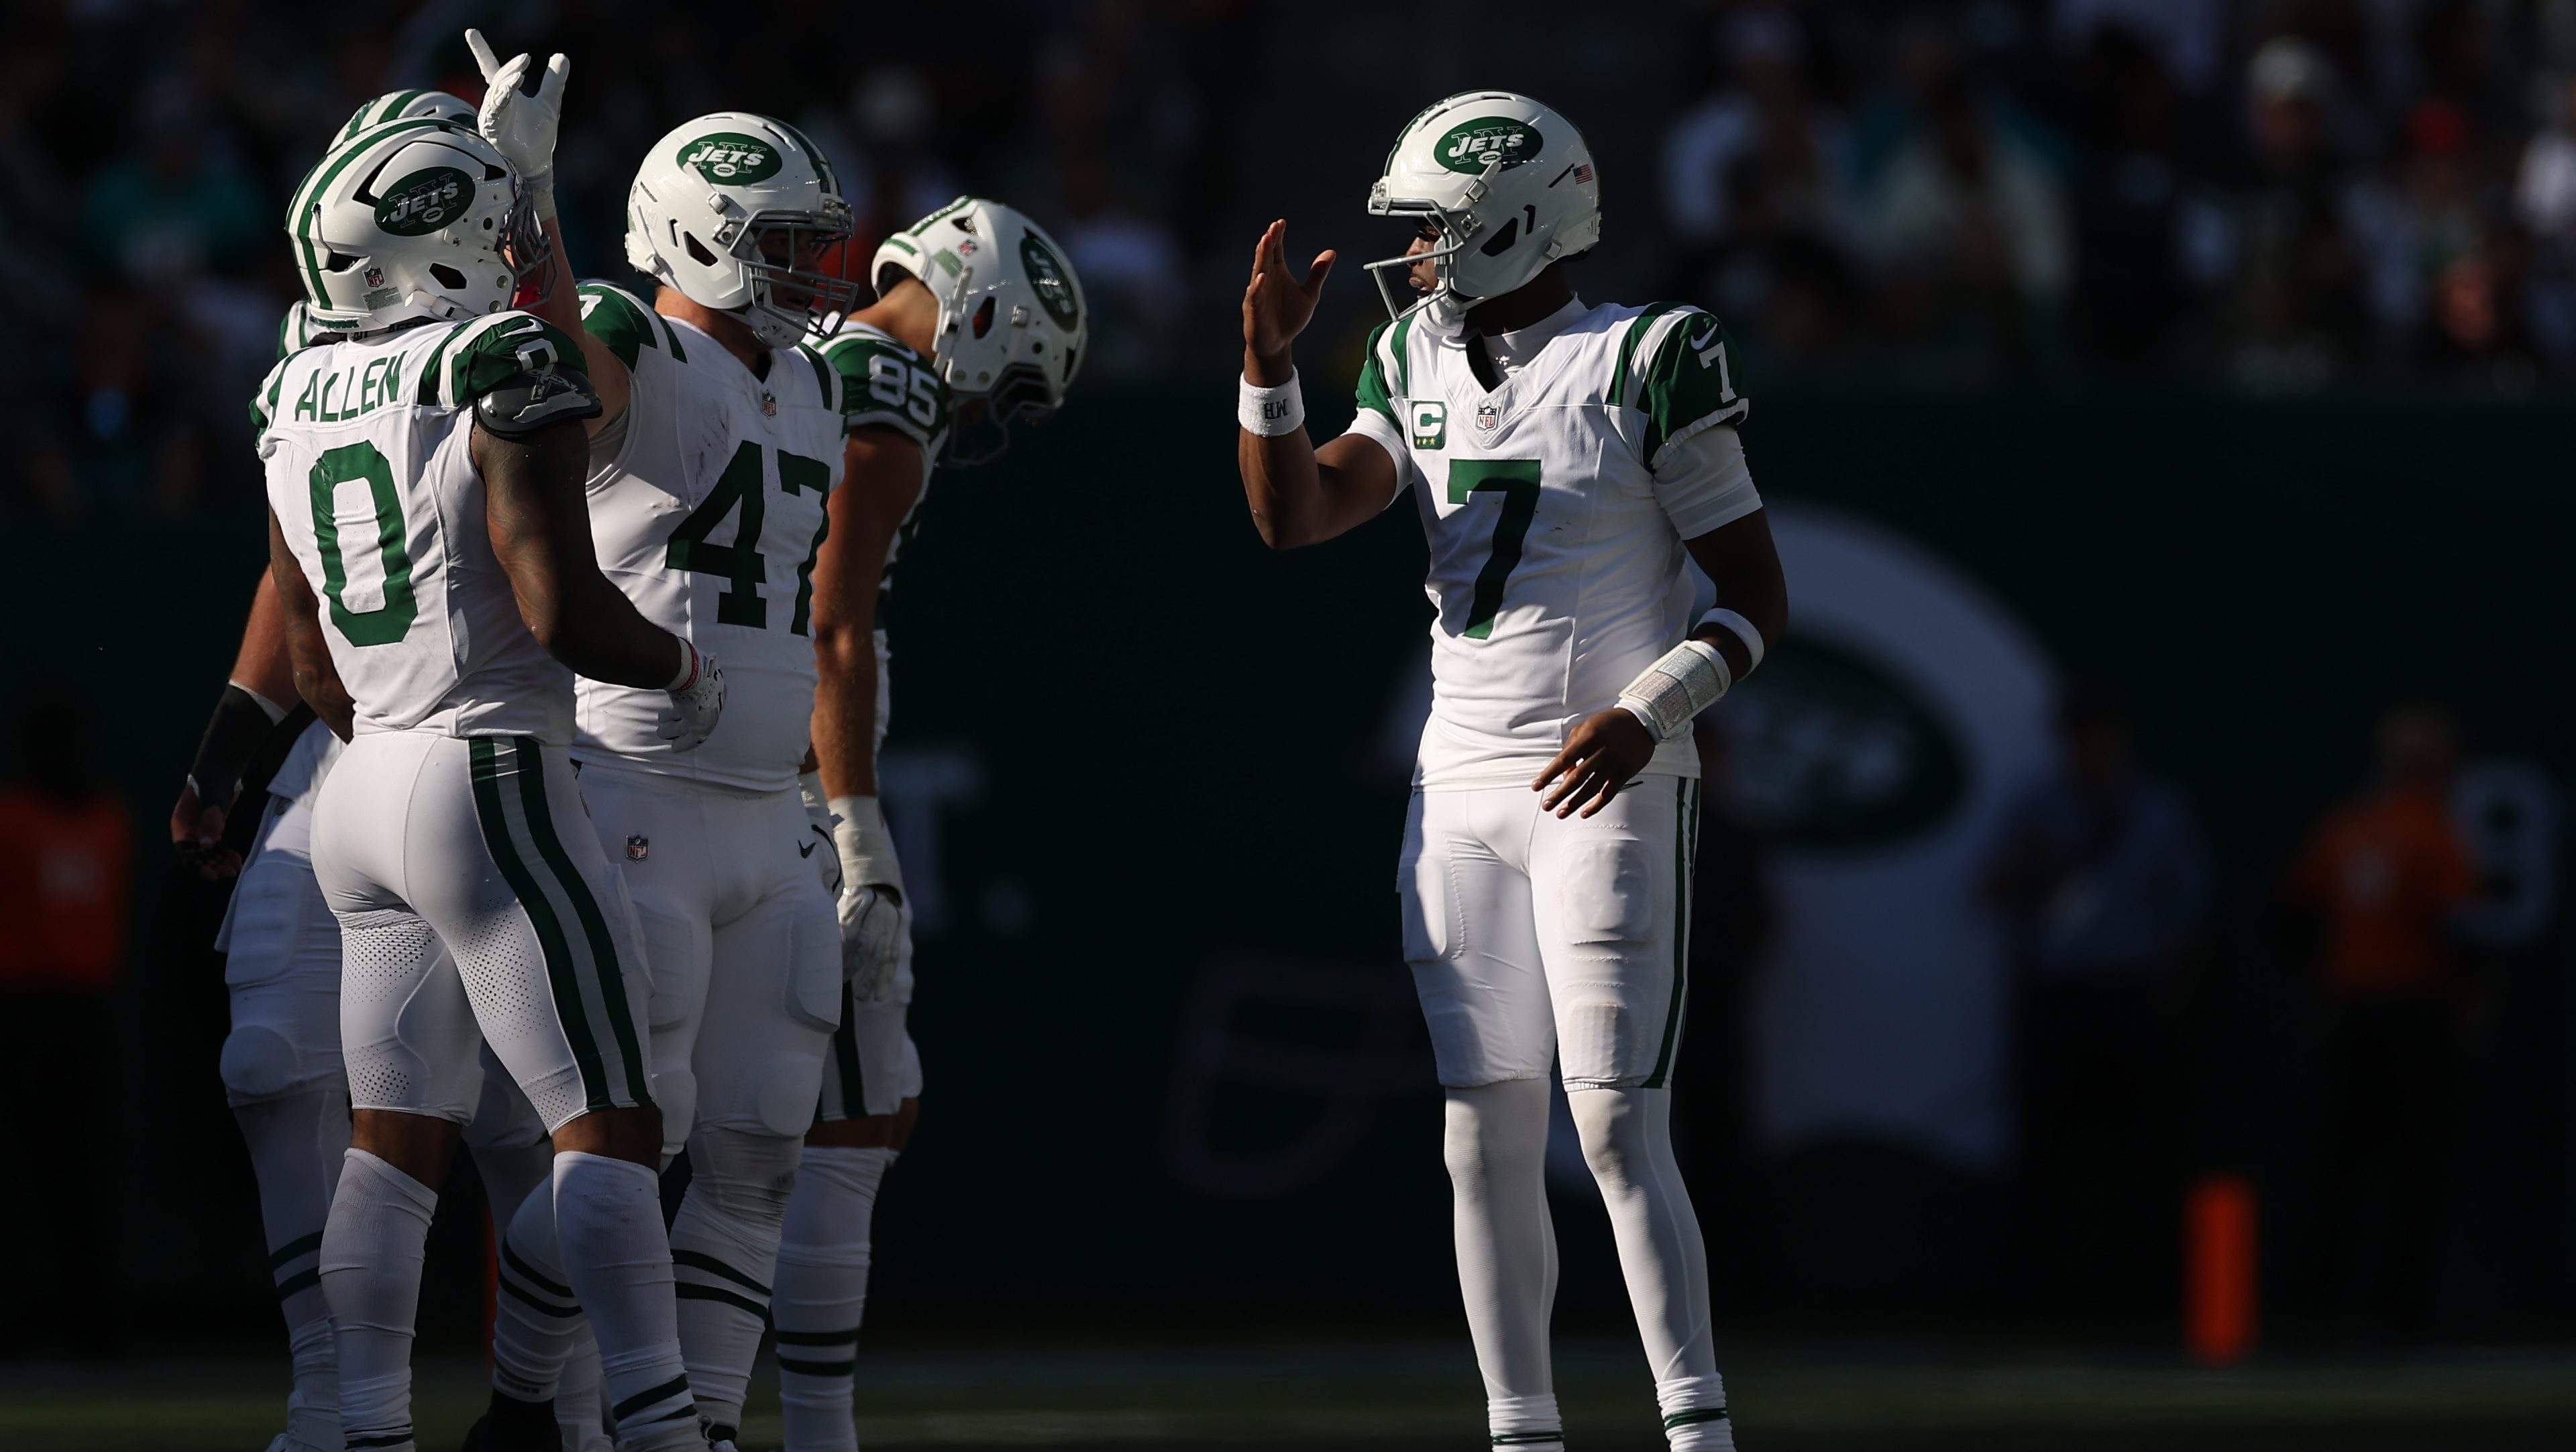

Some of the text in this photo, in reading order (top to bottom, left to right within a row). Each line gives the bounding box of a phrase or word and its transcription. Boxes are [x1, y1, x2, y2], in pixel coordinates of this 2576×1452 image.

[688, 146, 765, 166] JETS
[1448, 134, 1524, 158] JETS
[389, 181, 459, 223] JETS
[294, 350, 407, 423] ALLEN
[868, 354, 939, 427] 85
[1698, 341, 1737, 403] 7
[1412, 404, 1443, 437] C
[1478, 415, 1495, 427] NFL
[309, 439, 418, 647] 0
[664, 439, 831, 637] 47
[1447, 458, 1541, 641] 7
